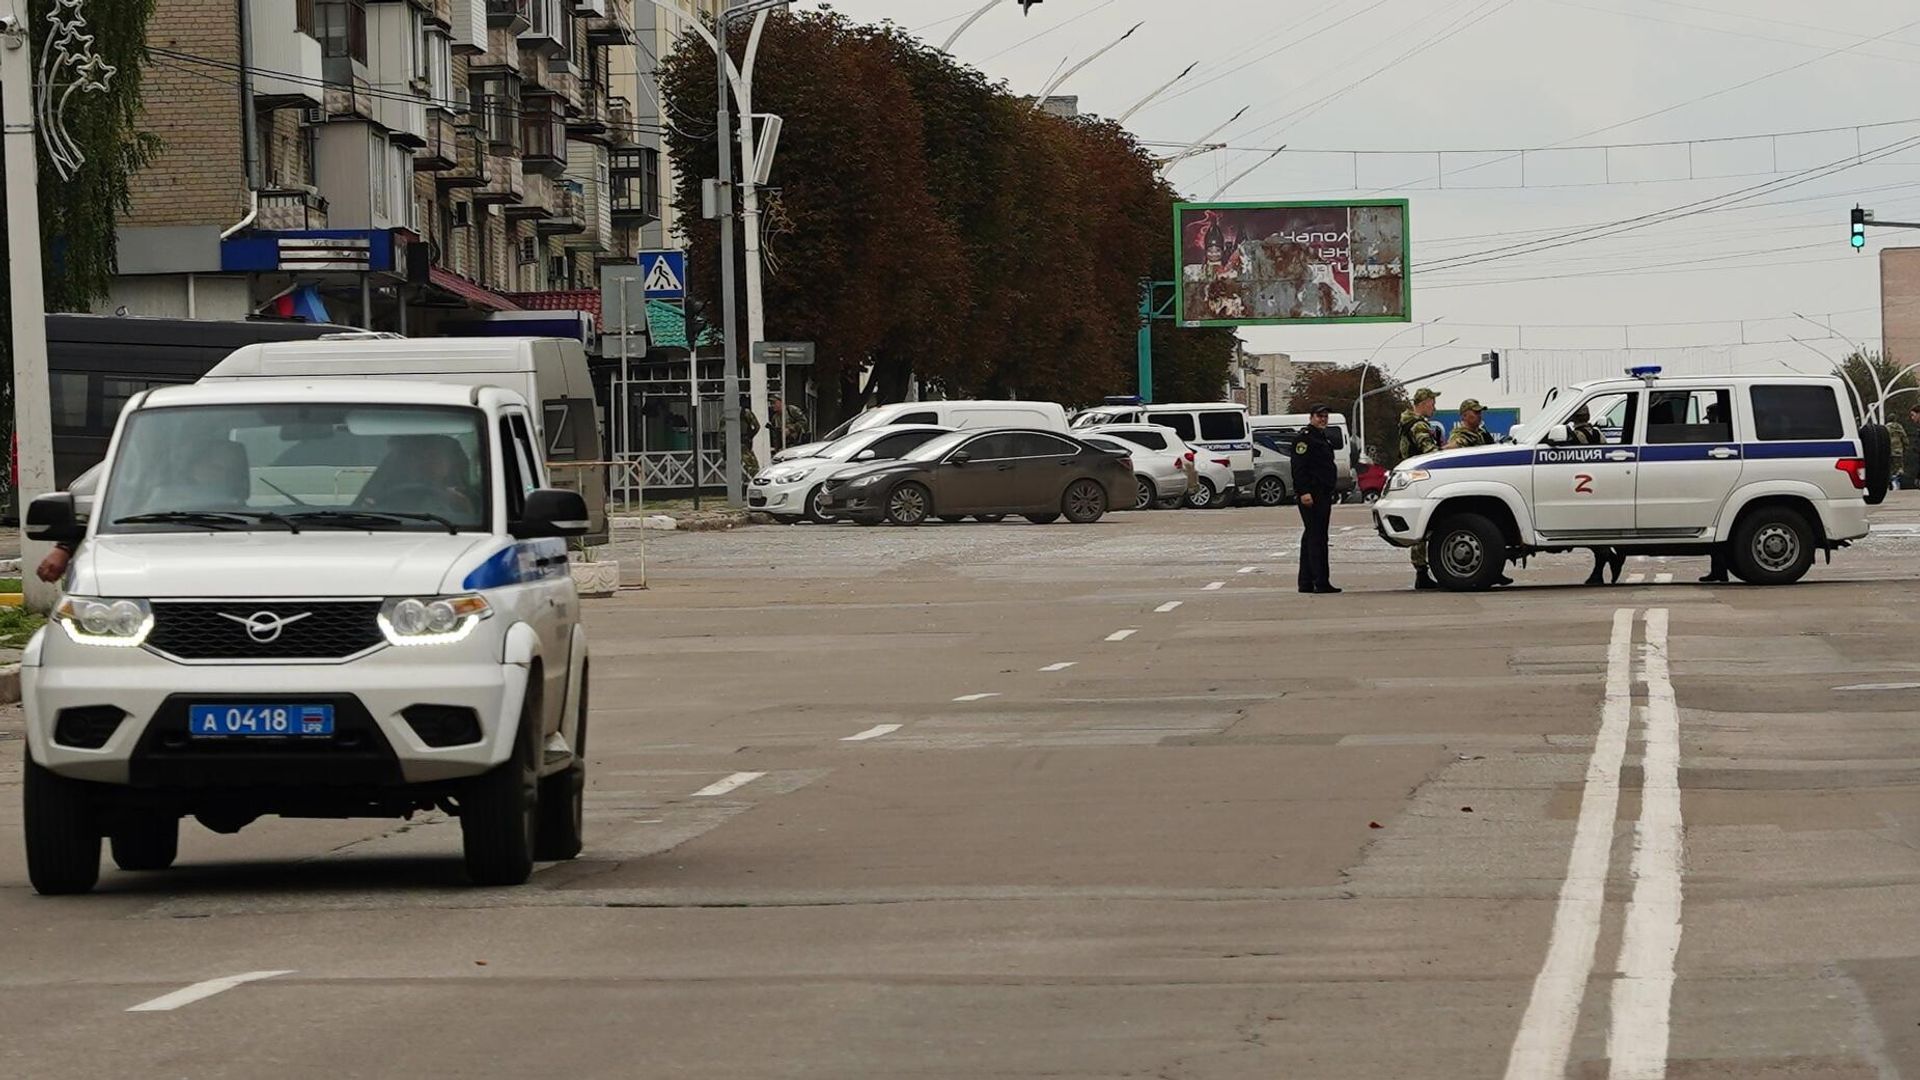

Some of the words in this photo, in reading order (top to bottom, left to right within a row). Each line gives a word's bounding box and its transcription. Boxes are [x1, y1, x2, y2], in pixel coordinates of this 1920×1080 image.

[545, 404, 575, 455] Z
[1539, 449, 1602, 462] ПОЛИЦИЯ
[226, 708, 287, 731] 0418
